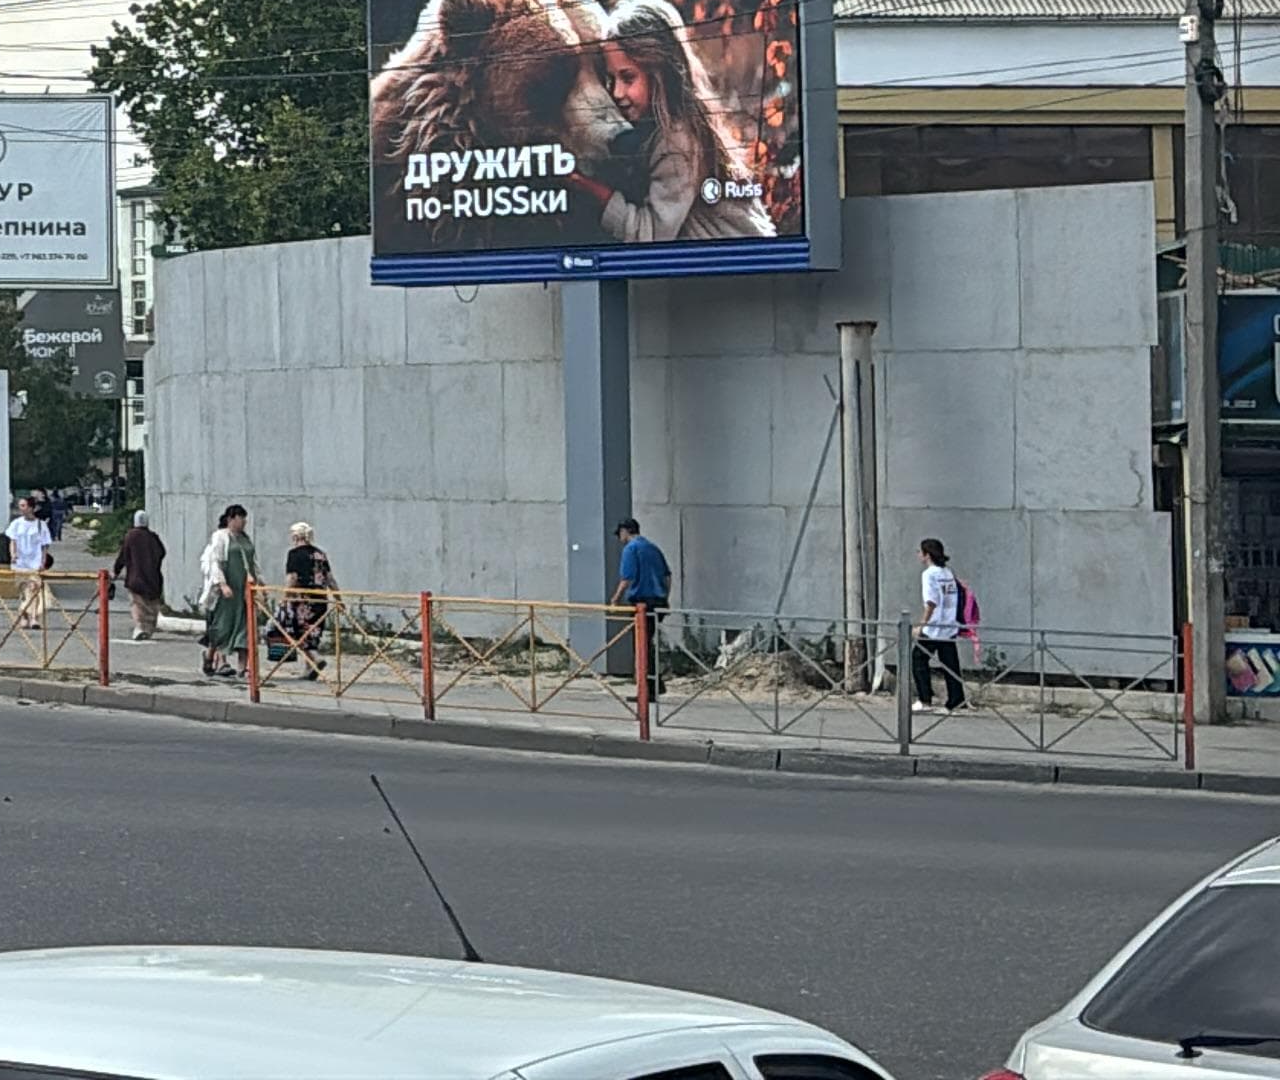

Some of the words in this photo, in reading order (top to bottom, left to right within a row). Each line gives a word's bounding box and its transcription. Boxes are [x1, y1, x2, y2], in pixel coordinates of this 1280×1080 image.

[403, 143, 577, 191] ДРУЖИТЬ
[724, 181, 763, 199] Russ
[23, 327, 103, 343] Бежевой
